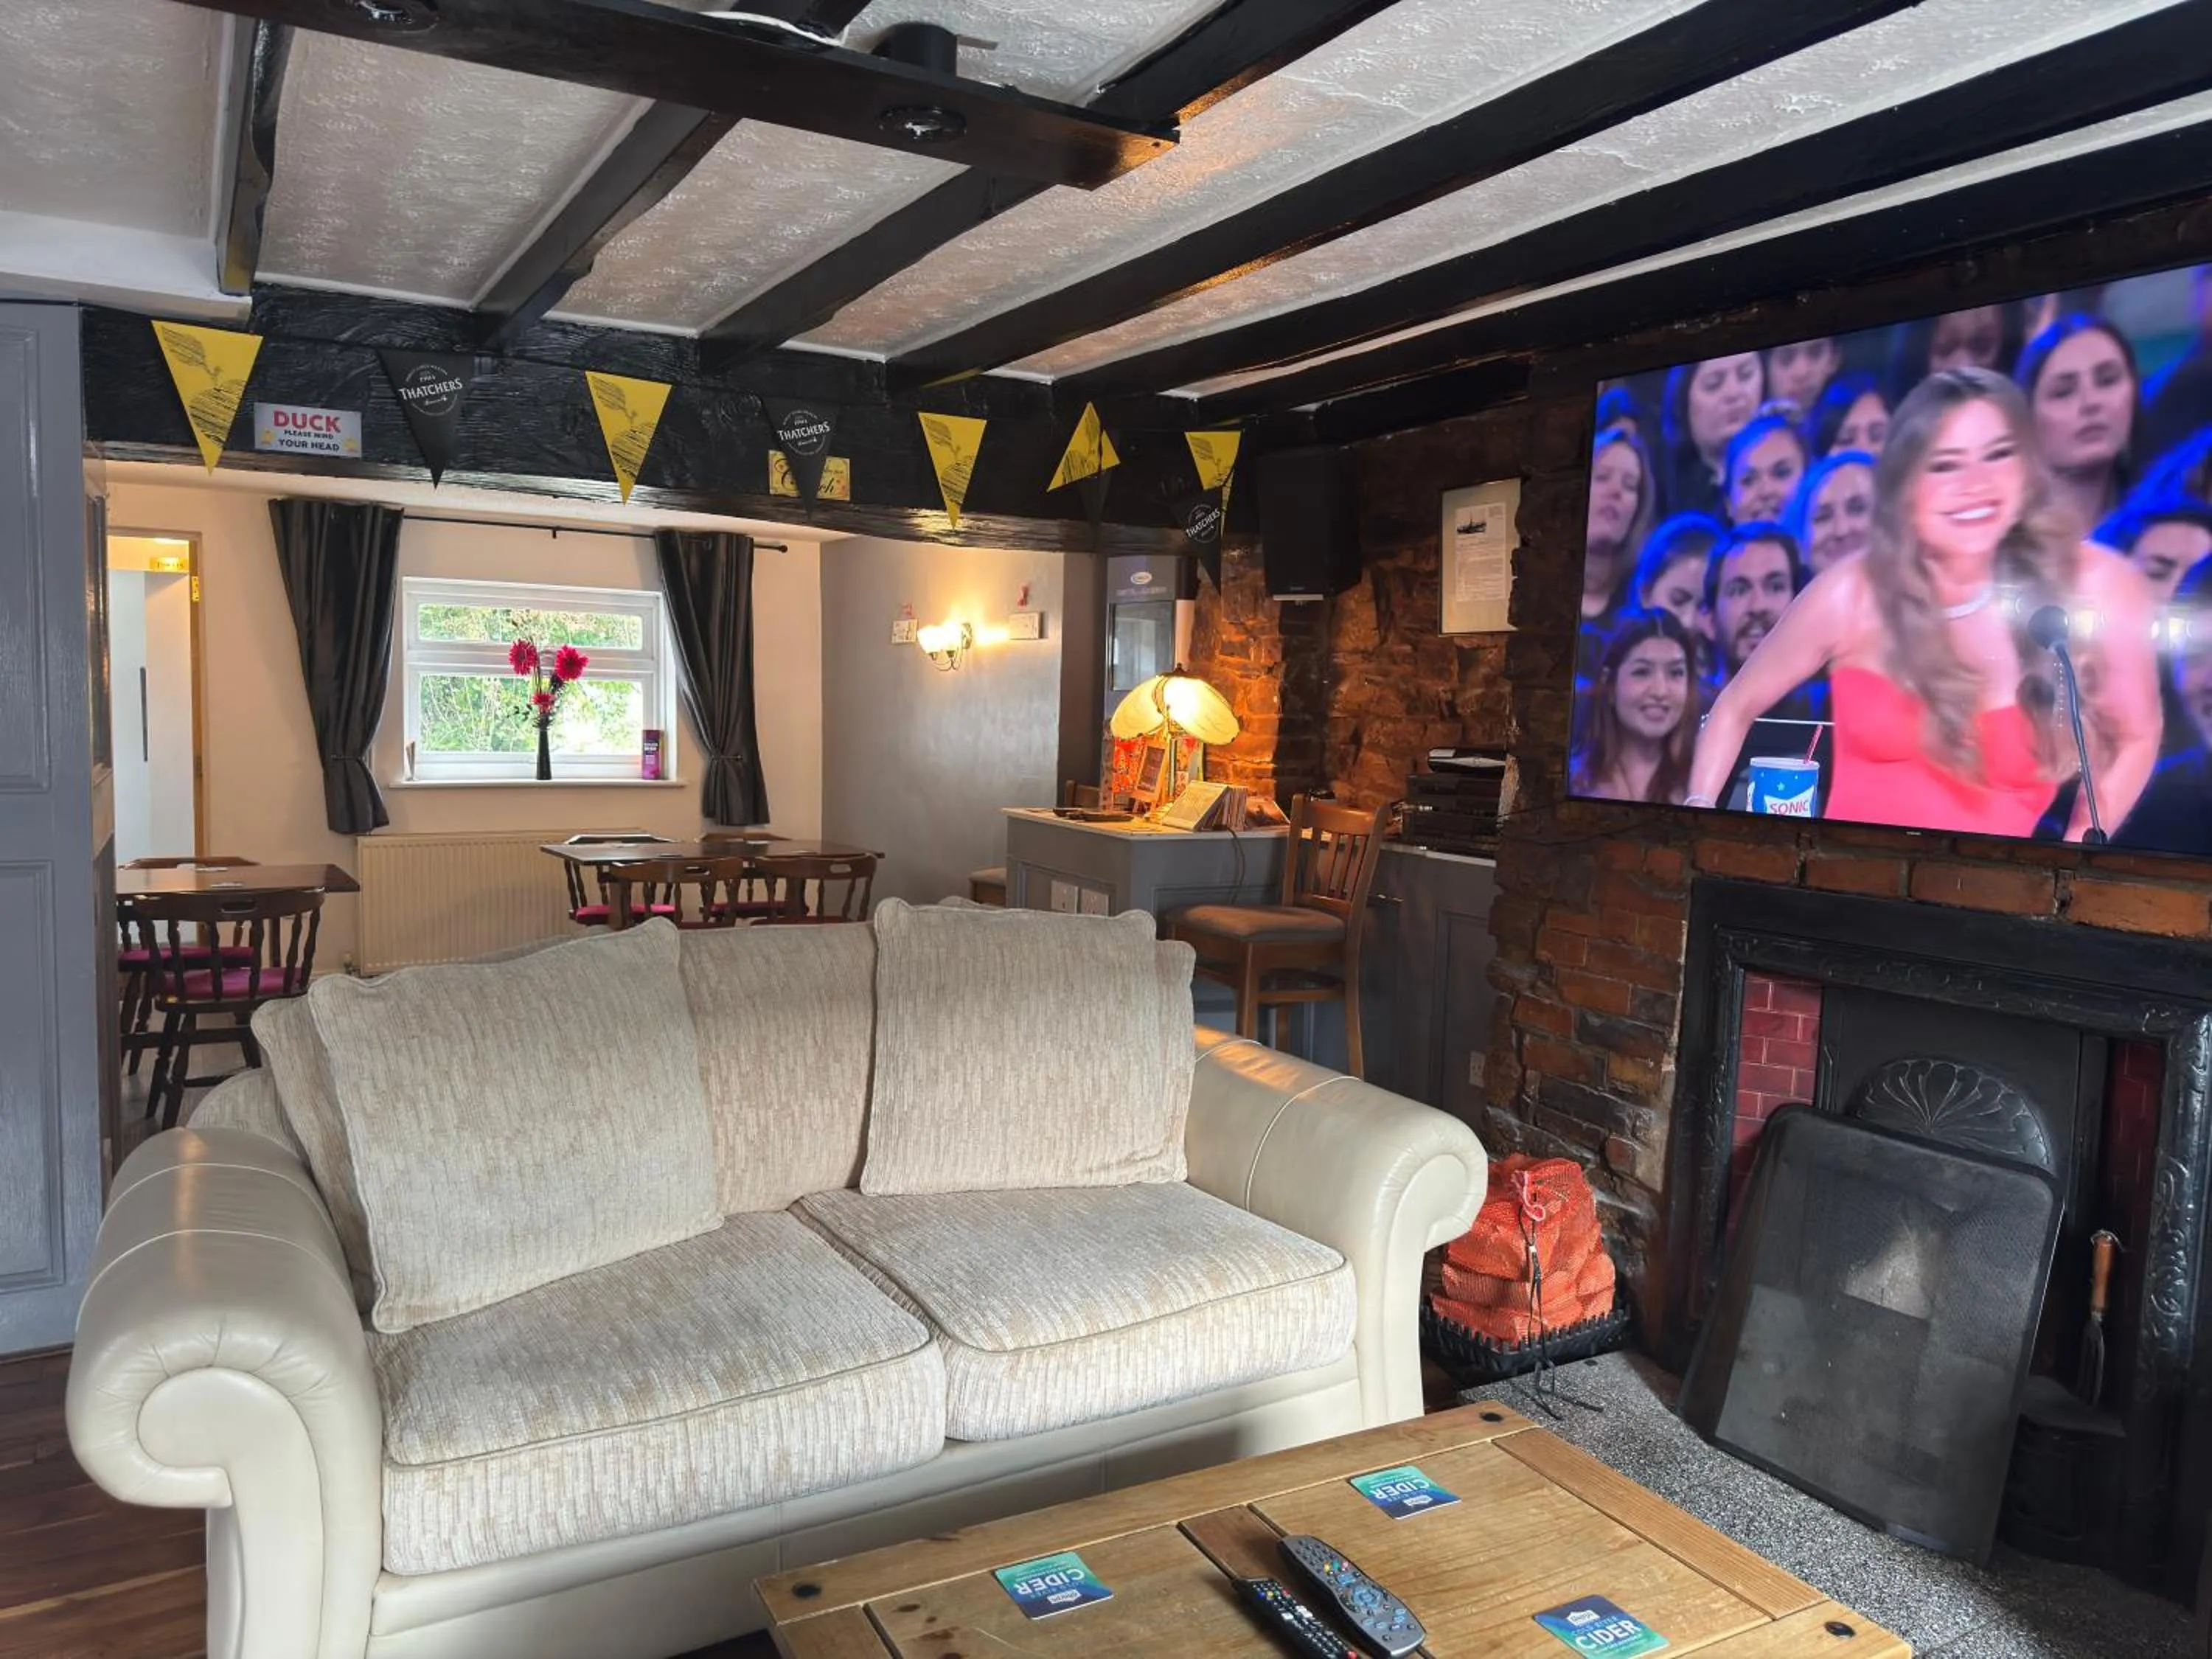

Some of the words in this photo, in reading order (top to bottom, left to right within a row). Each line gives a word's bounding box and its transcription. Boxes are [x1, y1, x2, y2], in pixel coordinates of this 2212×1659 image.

[398, 377, 463, 400] THATCHERS
[274, 410, 341, 434] DUCK
[776, 421, 831, 441] THATCHERS
[278, 439, 308, 449] YOUR
[310, 442, 340, 452] HEAD
[1186, 507, 1220, 538] THATCHERS
[1770, 800, 1809, 815] SONIC
[1368, 1478, 1430, 1500] CIDER
[1013, 1568, 1085, 1596] CIDER
[1575, 1620, 1642, 1649] CIDER
